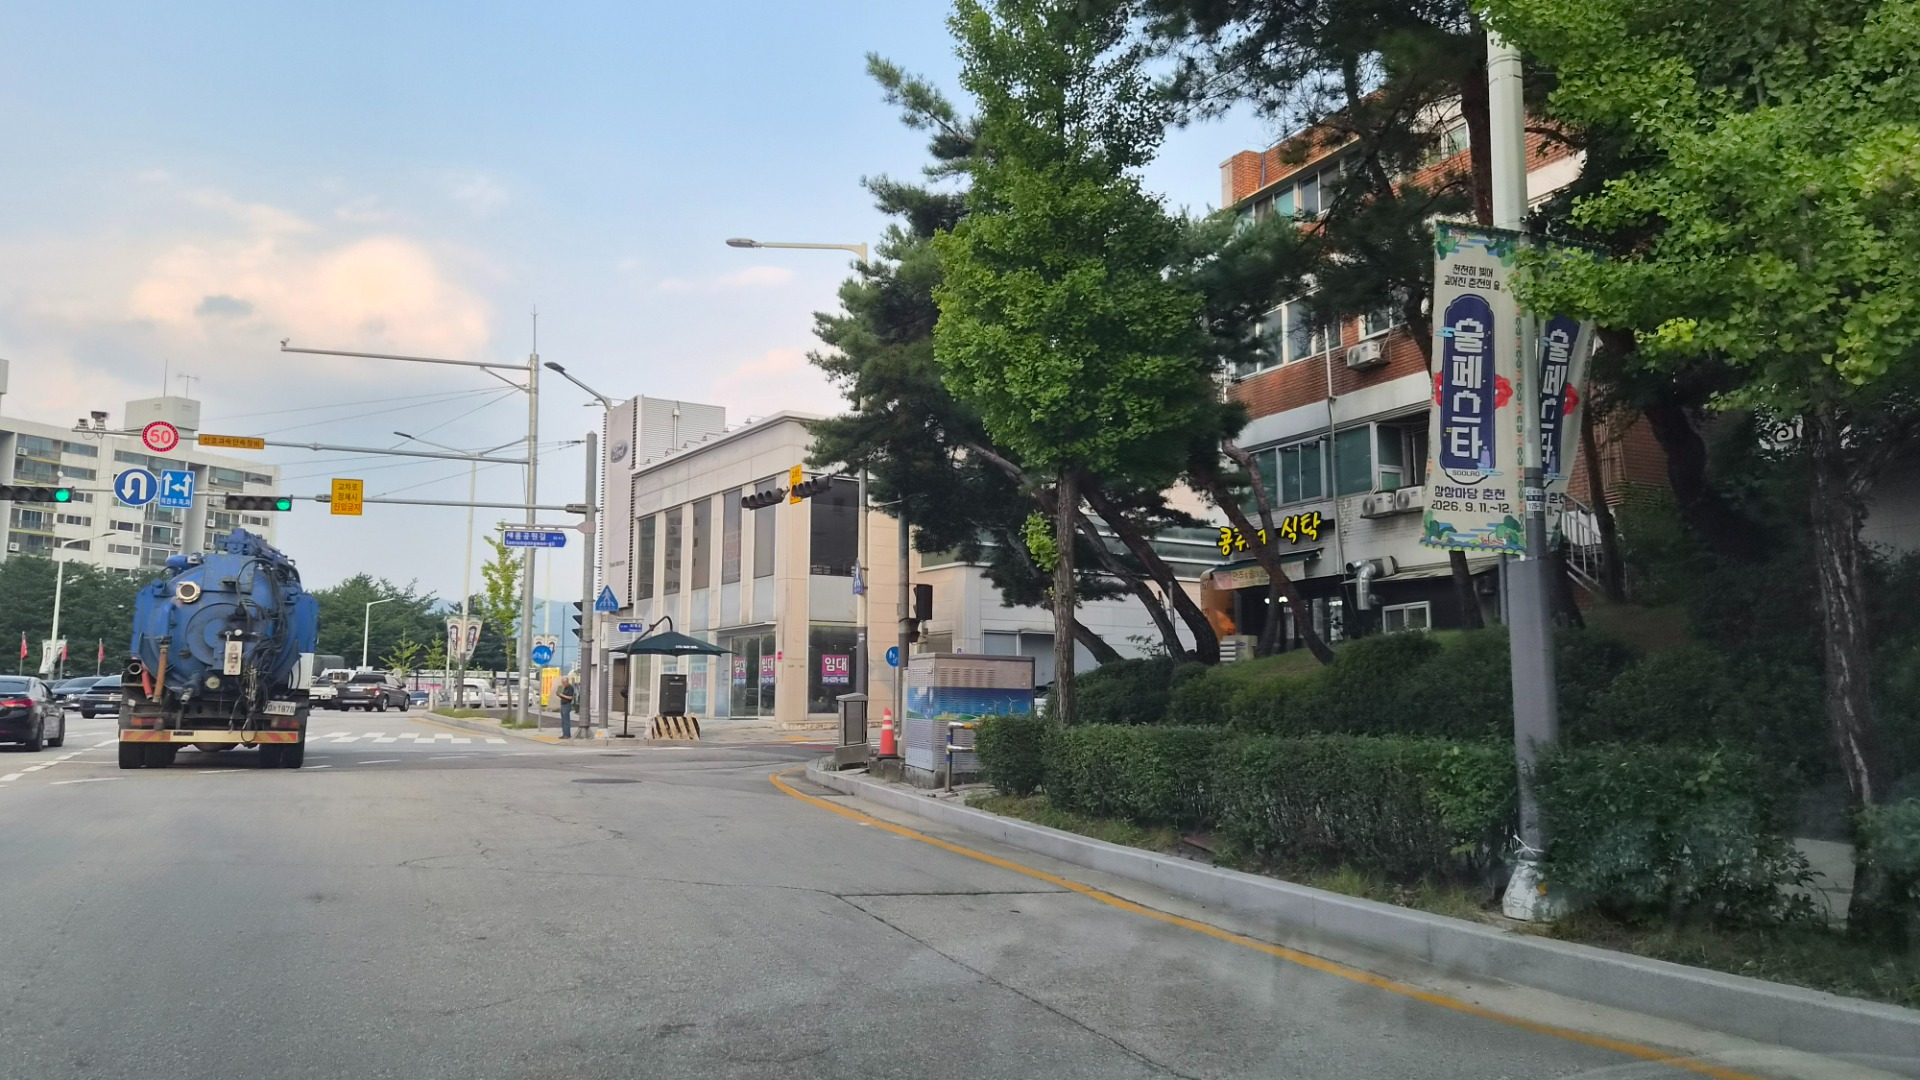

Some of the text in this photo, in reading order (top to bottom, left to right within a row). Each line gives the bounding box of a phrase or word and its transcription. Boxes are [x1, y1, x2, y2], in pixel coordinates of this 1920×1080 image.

[1452, 264, 1494, 278] 천천히 빚어
[1468, 278, 1492, 290] 춘천의
[1493, 280, 1500, 291] 술
[1450, 317, 1485, 460] 술페스타
[150, 430, 171, 444] 50
[338, 483, 358, 491] 교차로
[1434, 485, 1478, 500] 상상마당
[1482, 488, 1506, 501] 춘천
[338, 492, 358, 501] 정체시
[333, 502, 361, 512] 진입금지
[1431, 500, 1462, 512] 2026.
[1465, 501, 1477, 513] 9.
[1281, 511, 1321, 544] 식탁
[762, 657, 774, 672] 임대
[824, 657, 847, 672] 임대
